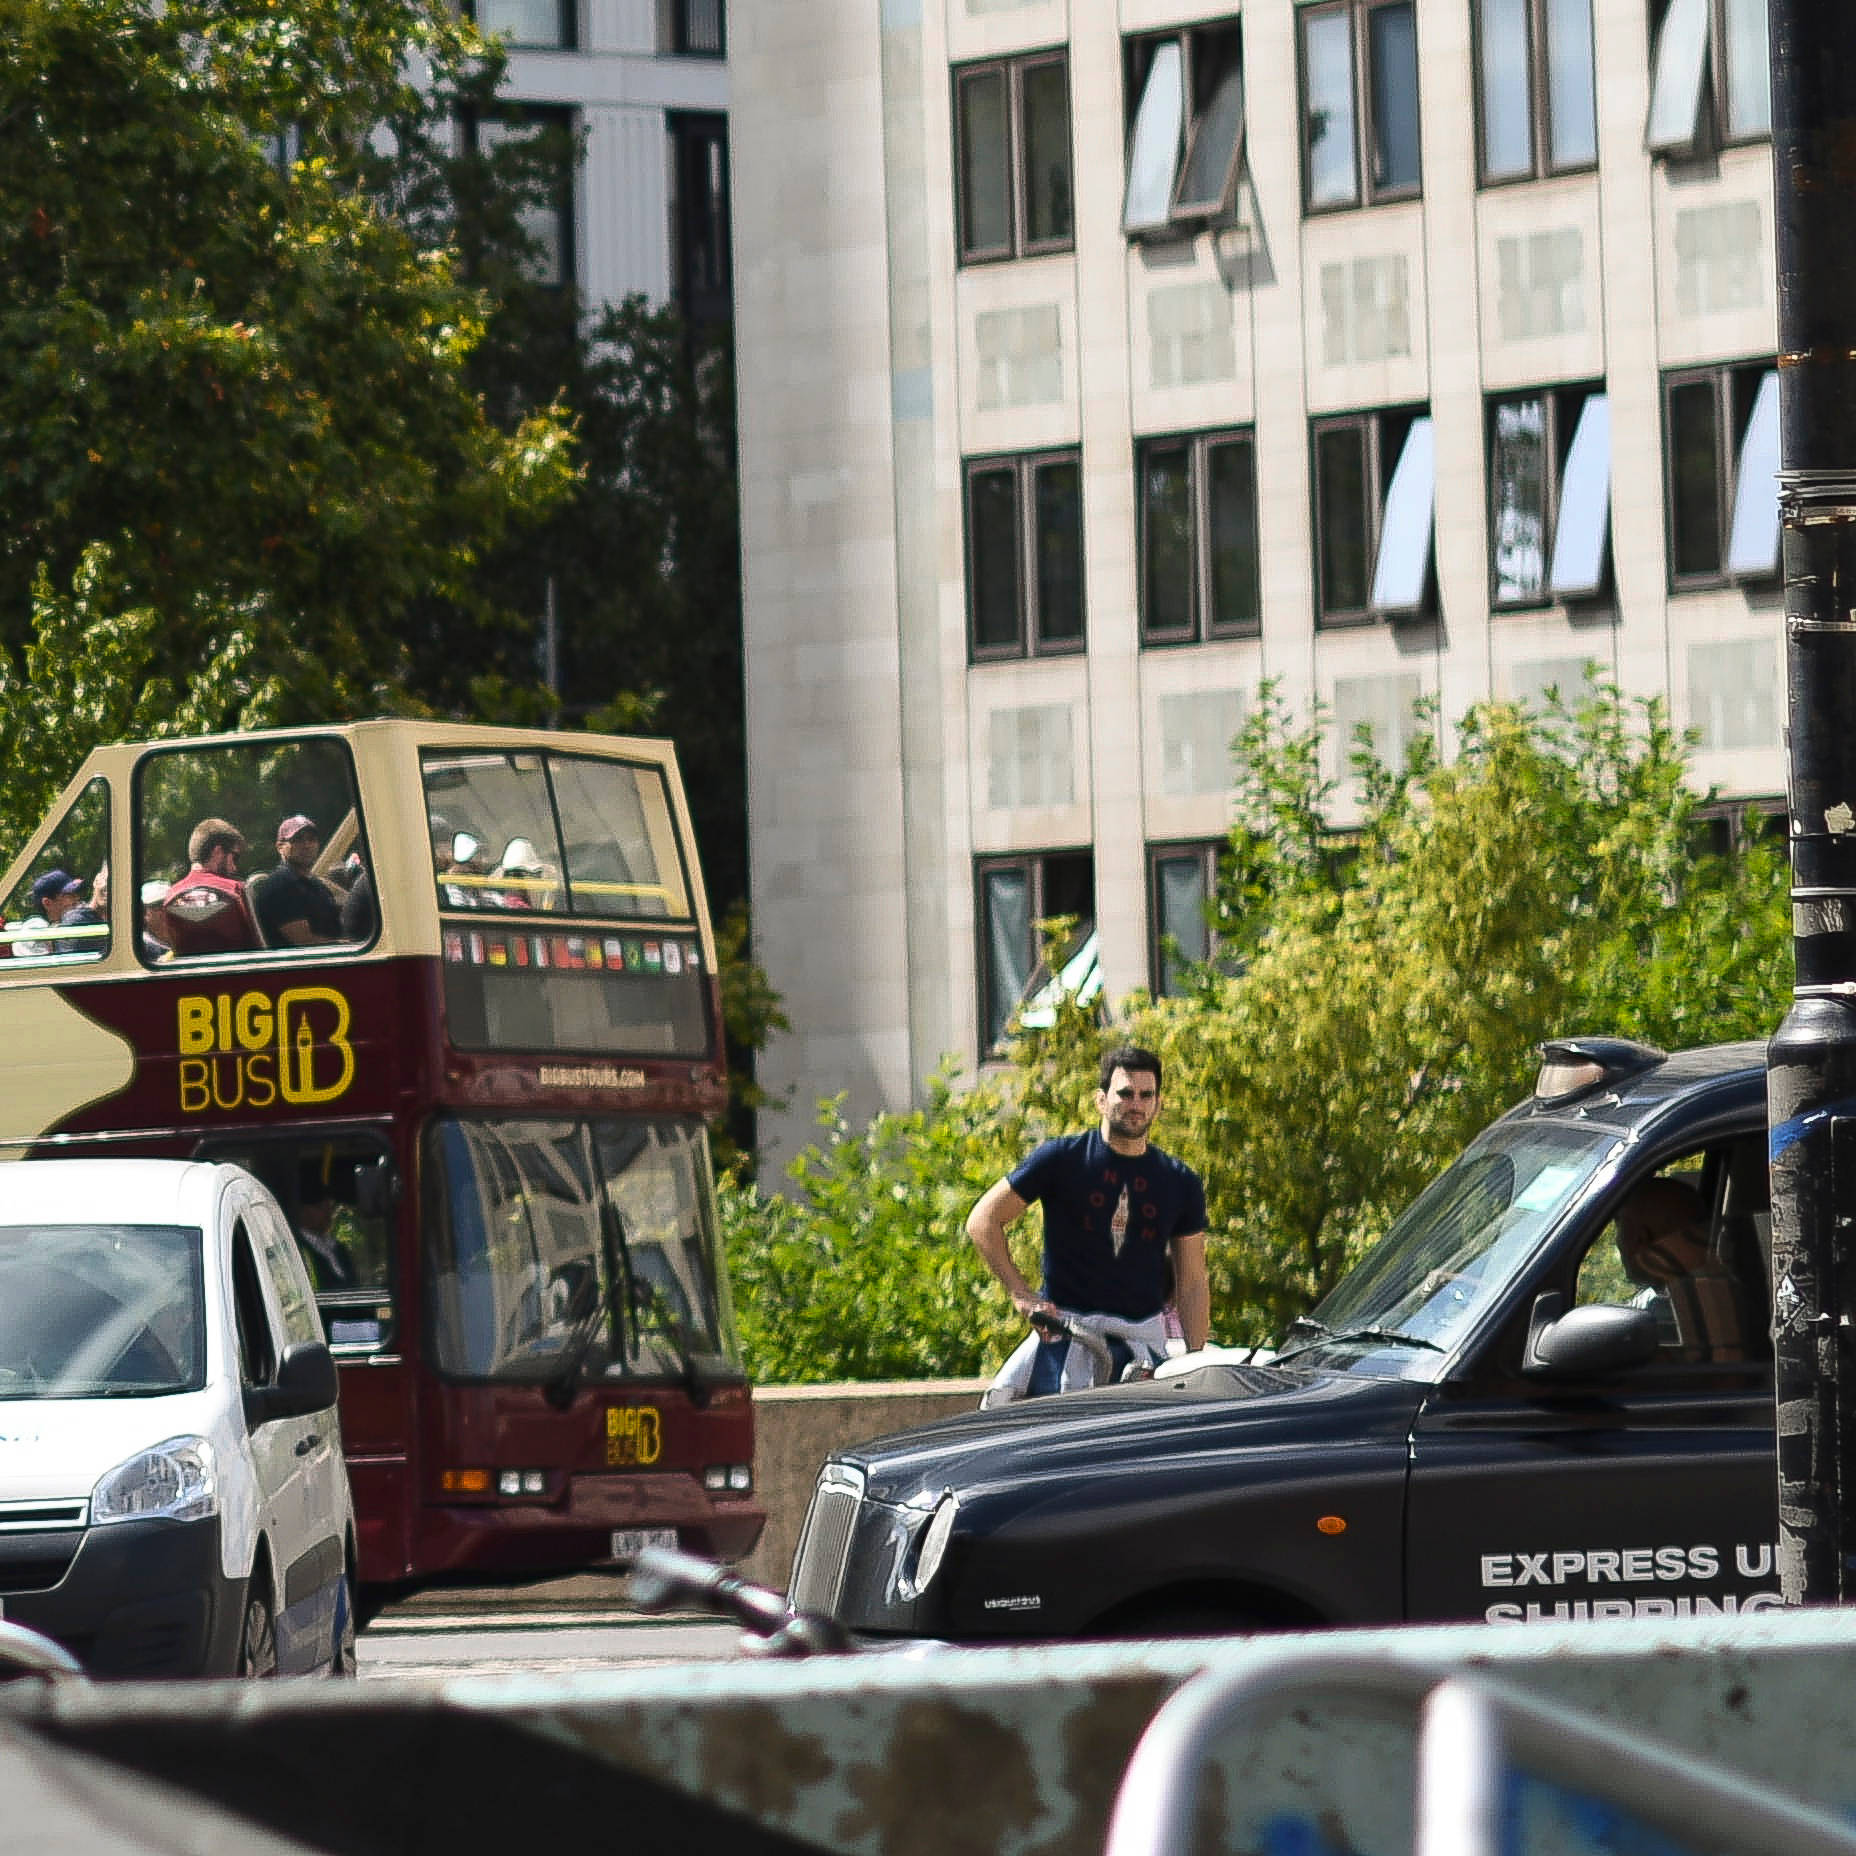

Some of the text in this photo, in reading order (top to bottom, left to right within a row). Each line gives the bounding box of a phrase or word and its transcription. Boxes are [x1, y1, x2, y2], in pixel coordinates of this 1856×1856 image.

[177, 991, 274, 1055] BIG
[180, 1055, 276, 1110] BUS
[1481, 1546, 1720, 1586] EXPRESS
